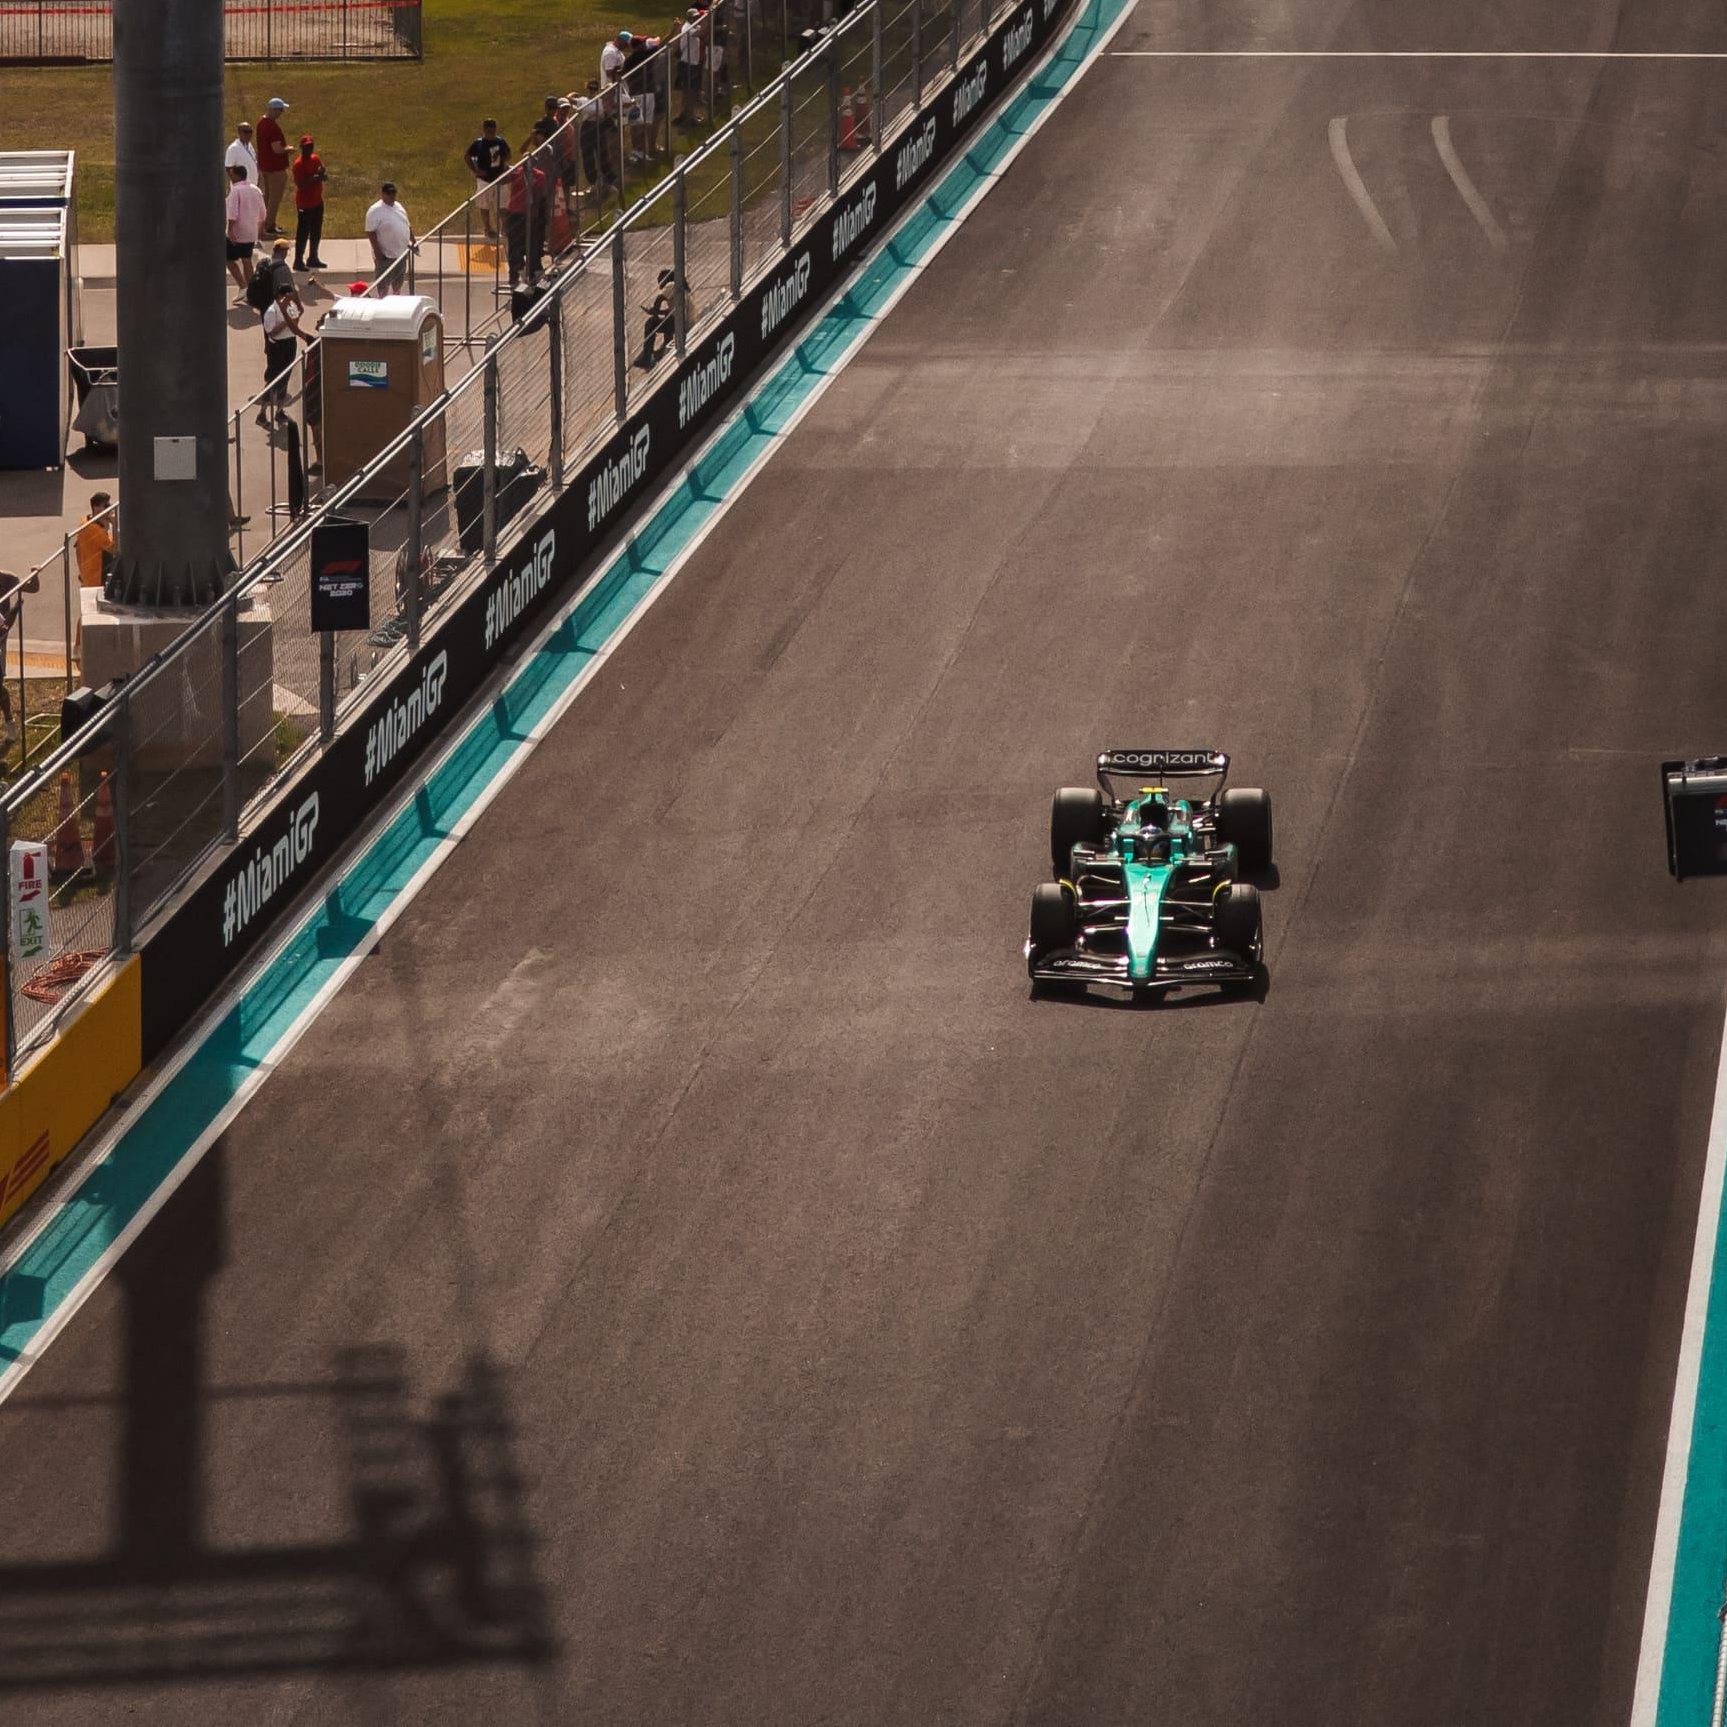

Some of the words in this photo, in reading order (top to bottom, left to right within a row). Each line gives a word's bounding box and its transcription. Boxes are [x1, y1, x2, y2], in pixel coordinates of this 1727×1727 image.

[953, 59, 987, 127] #MiamiGP
[897, 117, 935, 191] #MiamiGP
[832, 182, 877, 261] #MiamiGP
[761, 251, 810, 340] #MiamiGP
[678, 332, 734, 429] #MiamiGP
[587, 425, 650, 533] #MiamiGP
[319, 583, 337, 591] NET
[484, 529, 555, 650] #MiamiGP
[364, 649, 447, 784] #MiamiGP
[1113, 751, 1215, 767] cognizant
[18, 880, 42, 890] FIRE
[222, 791, 320, 946] #MiamiGP
[20, 935, 43, 946] EXIT
[1053, 959, 1102, 970] aramco
[1184, 959, 1234, 970] aramco
